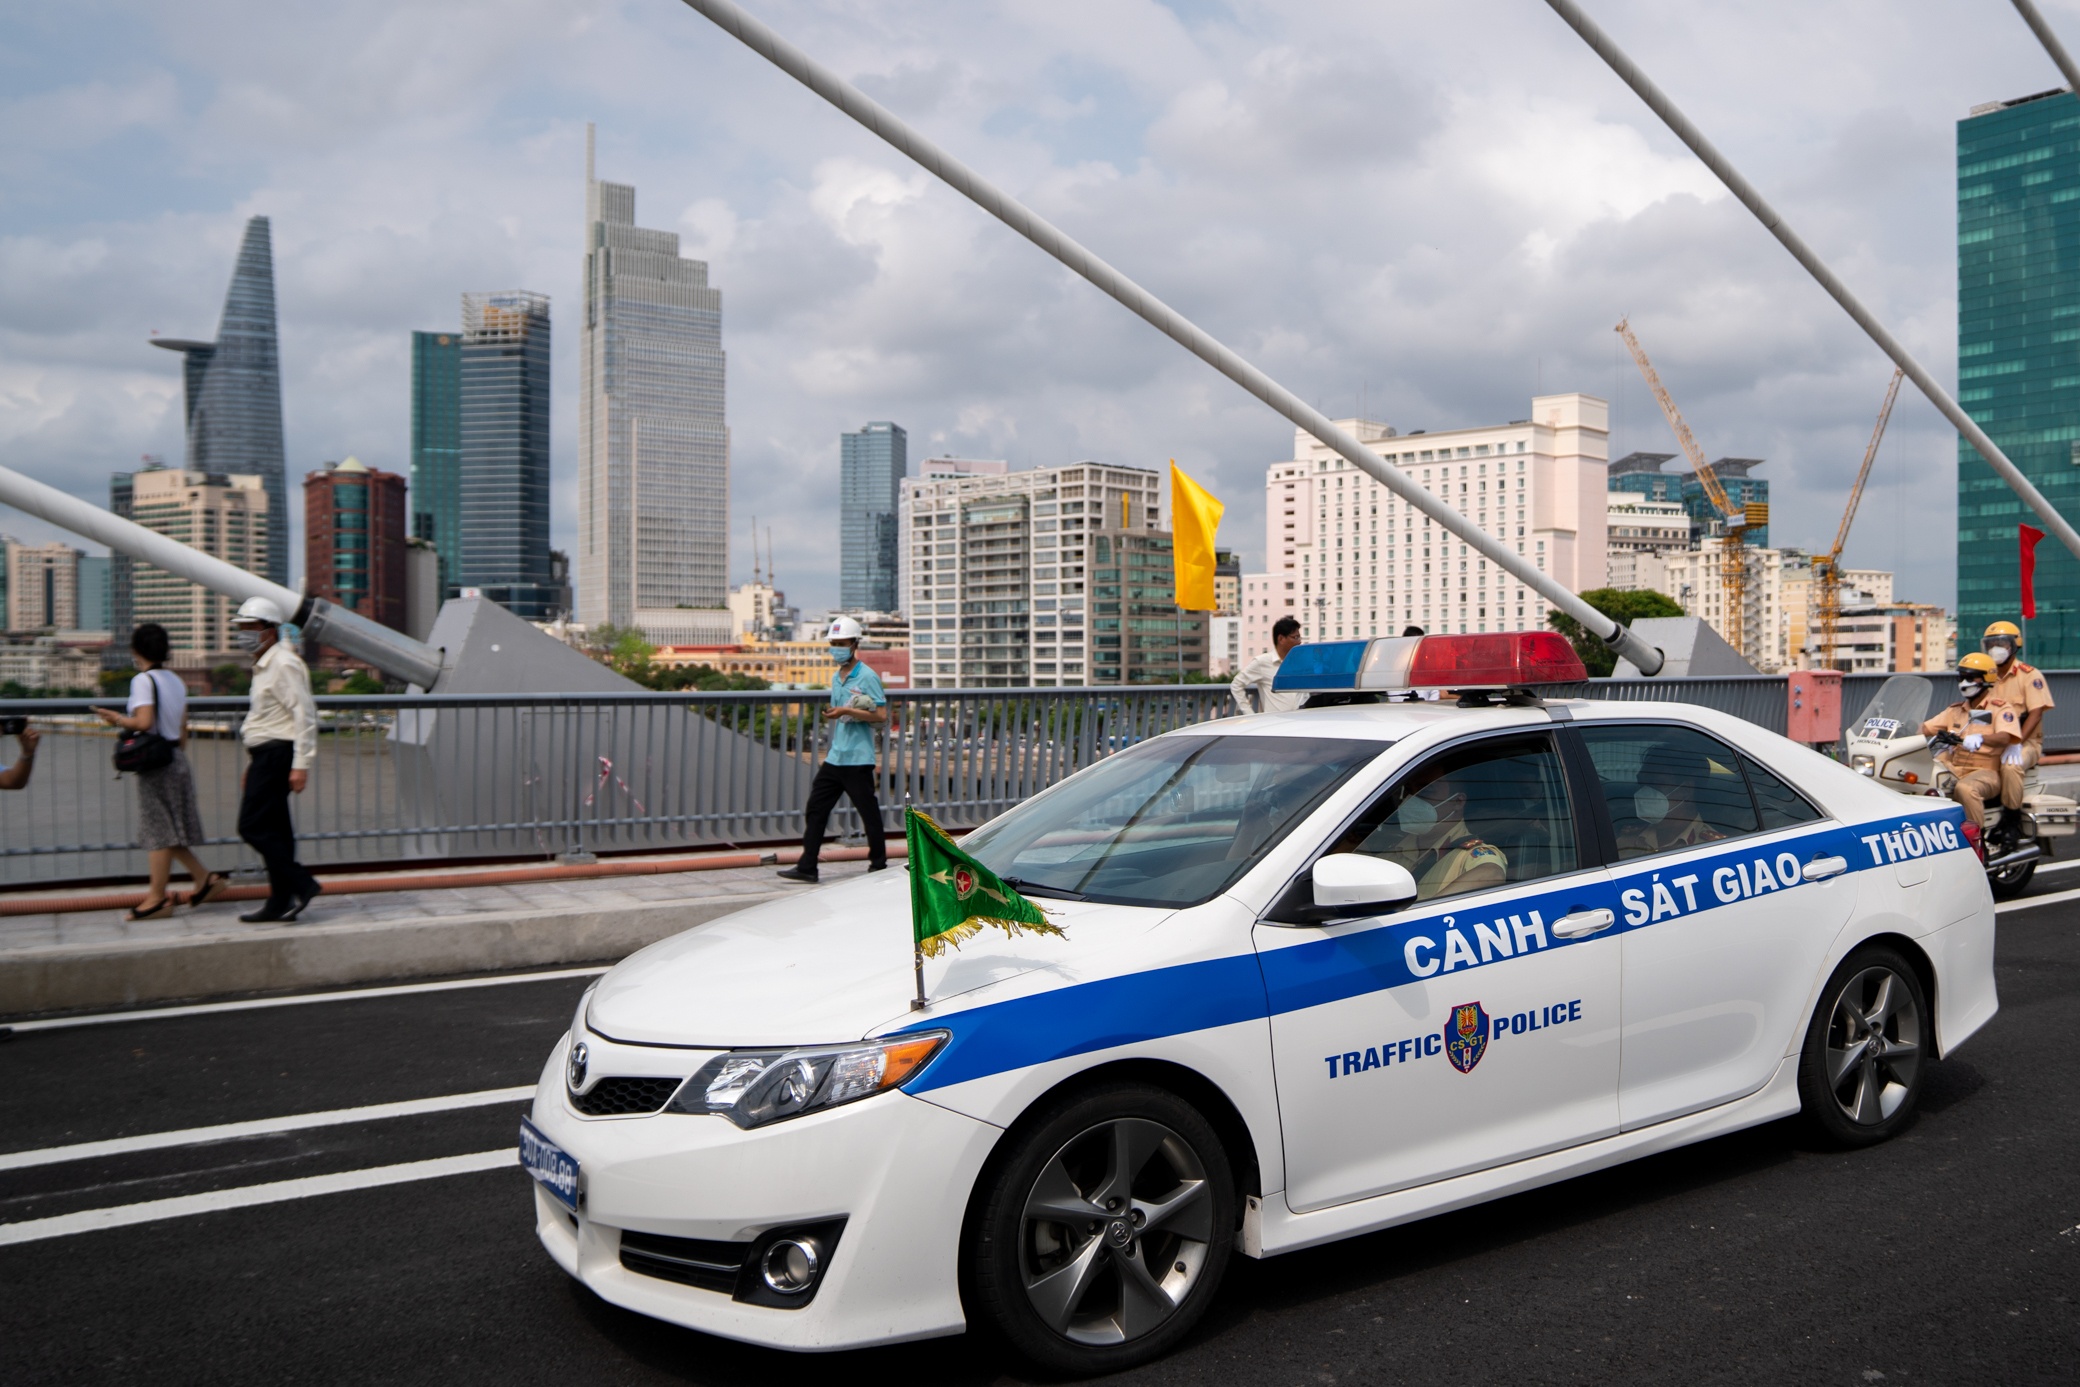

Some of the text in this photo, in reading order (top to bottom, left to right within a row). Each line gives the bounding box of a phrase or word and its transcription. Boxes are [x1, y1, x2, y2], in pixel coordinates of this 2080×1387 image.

[1866, 718, 1896, 729] POLICE
[1404, 820, 1960, 978] CẢNH SÁT GIAO THÔNG
[1324, 999, 1582, 1079] TRAFFIC POLICE
